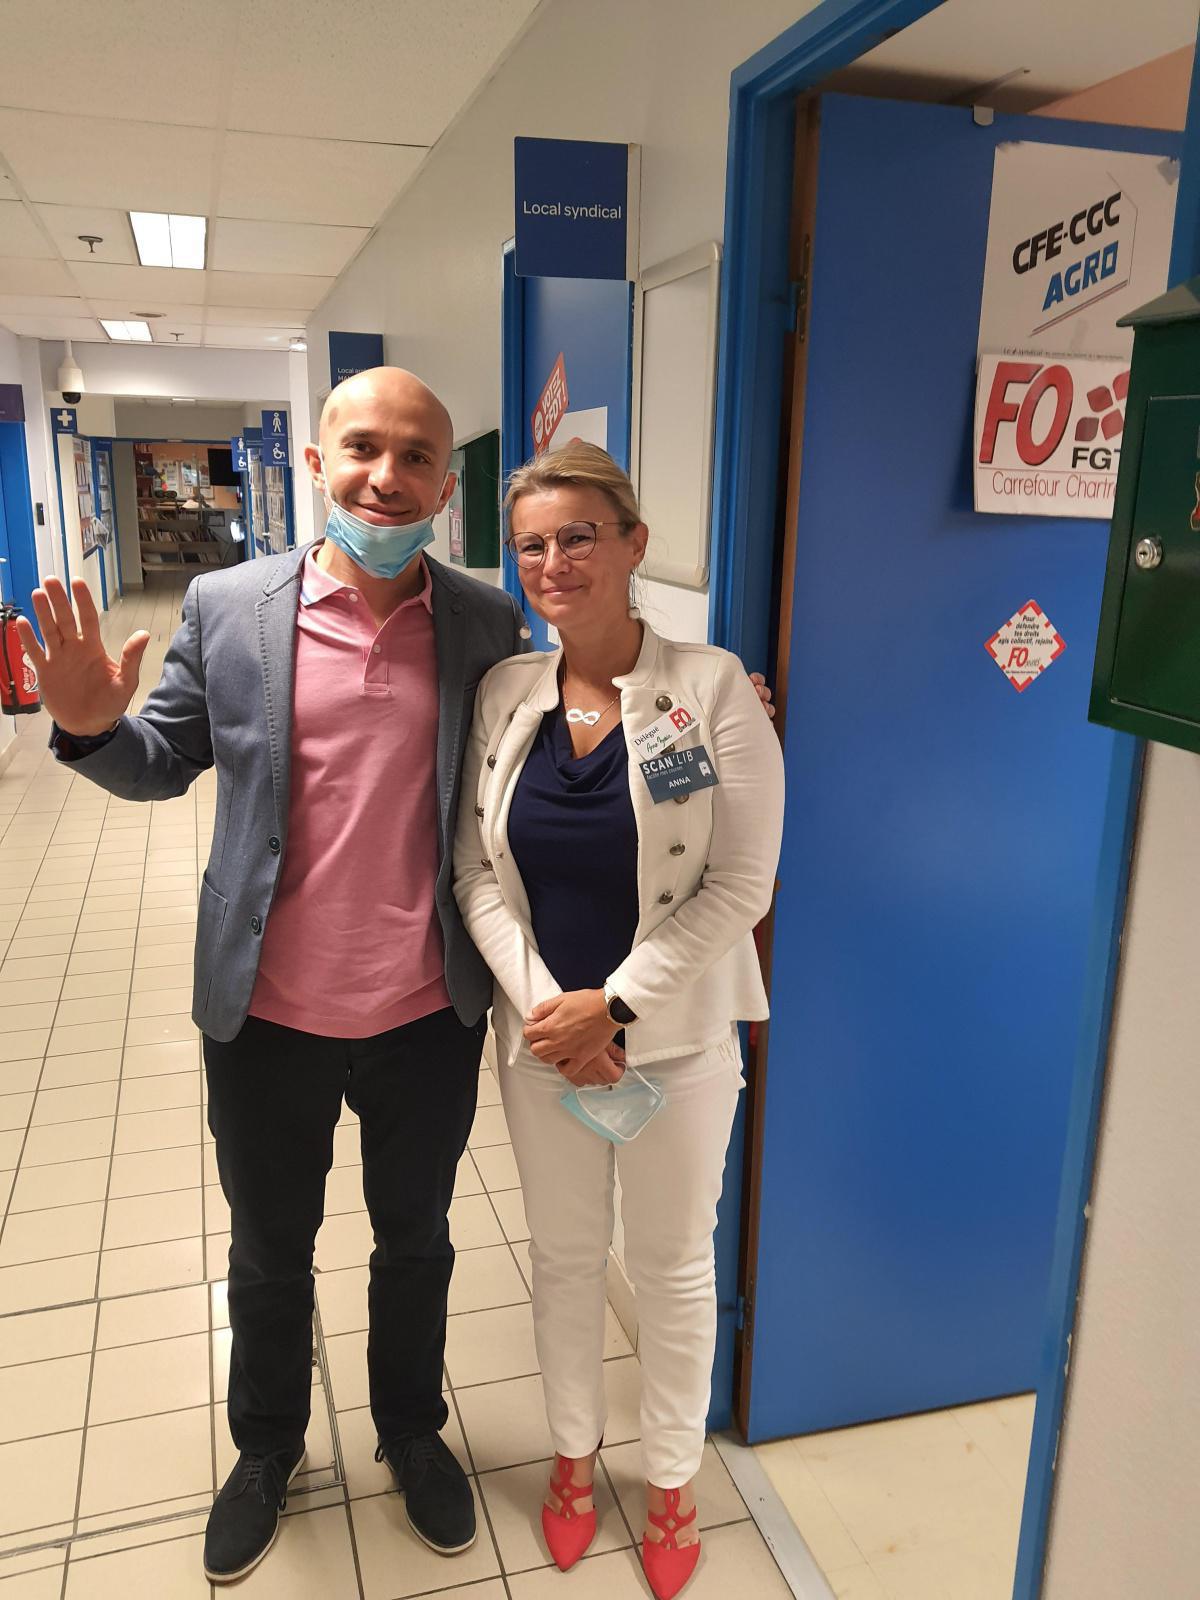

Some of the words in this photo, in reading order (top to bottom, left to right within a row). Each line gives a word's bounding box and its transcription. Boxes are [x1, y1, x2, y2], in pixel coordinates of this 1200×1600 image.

[523, 200, 561, 216] Local
[563, 203, 622, 220] syndical
[1042, 240, 1119, 312] AGRO
[541, 367, 561, 414] VOTEZ
[979, 361, 1074, 467] FO
[992, 470, 1060, 497] Carrefour
[1007, 646, 1029, 668] FO
[669, 707, 692, 733] FO
[668, 775, 691, 789] ANNA
